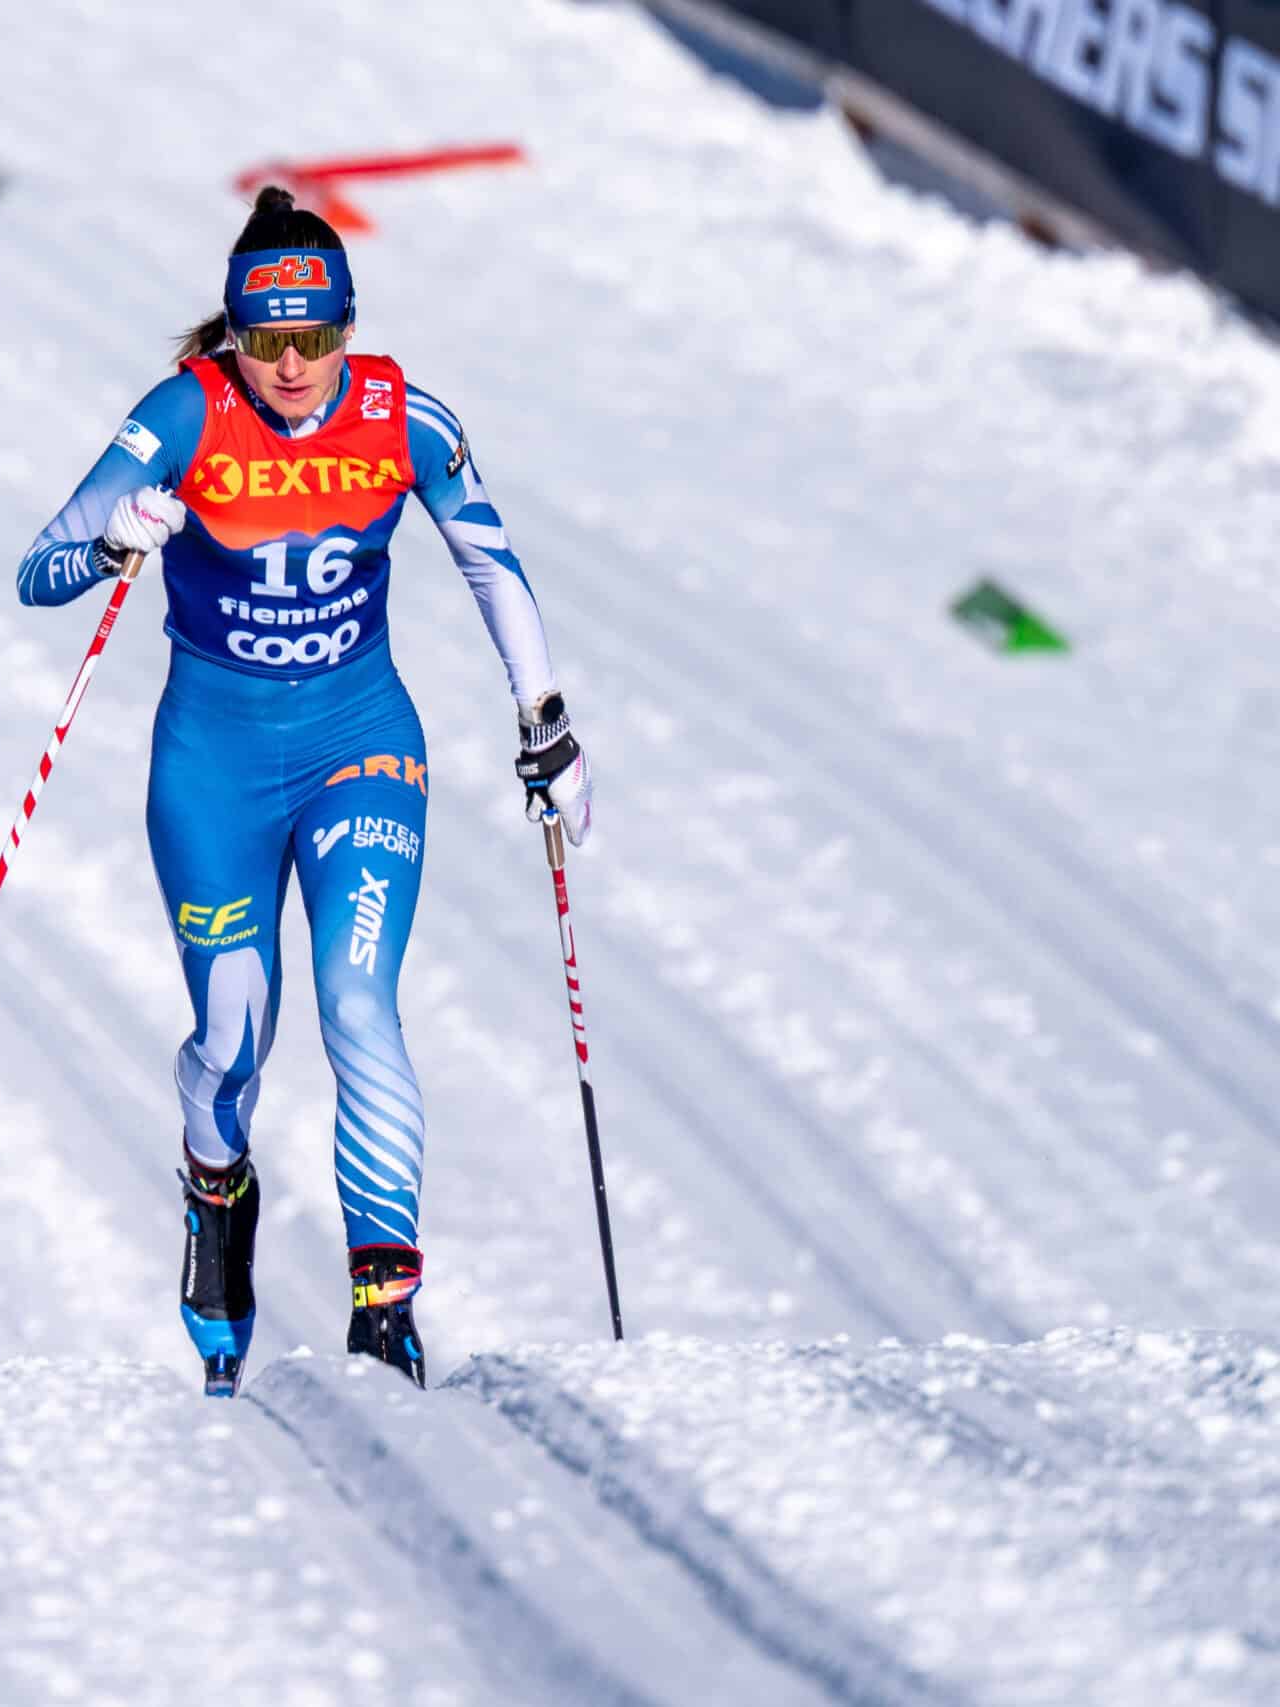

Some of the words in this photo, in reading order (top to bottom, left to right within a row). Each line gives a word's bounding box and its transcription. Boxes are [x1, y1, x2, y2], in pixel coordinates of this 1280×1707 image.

[925, 0, 1214, 159] HERS
[242, 256, 331, 295] st1
[248, 457, 403, 497] EXTRA
[48, 543, 92, 590] FIN
[250, 537, 359, 598] 16
[218, 587, 369, 625] fiemme
[227, 619, 360, 665] coop
[352, 831, 420, 864] SPORT
[355, 815, 420, 851] INTER
[178, 896, 253, 935] FF
[178, 924, 259, 947] FINNFORM
